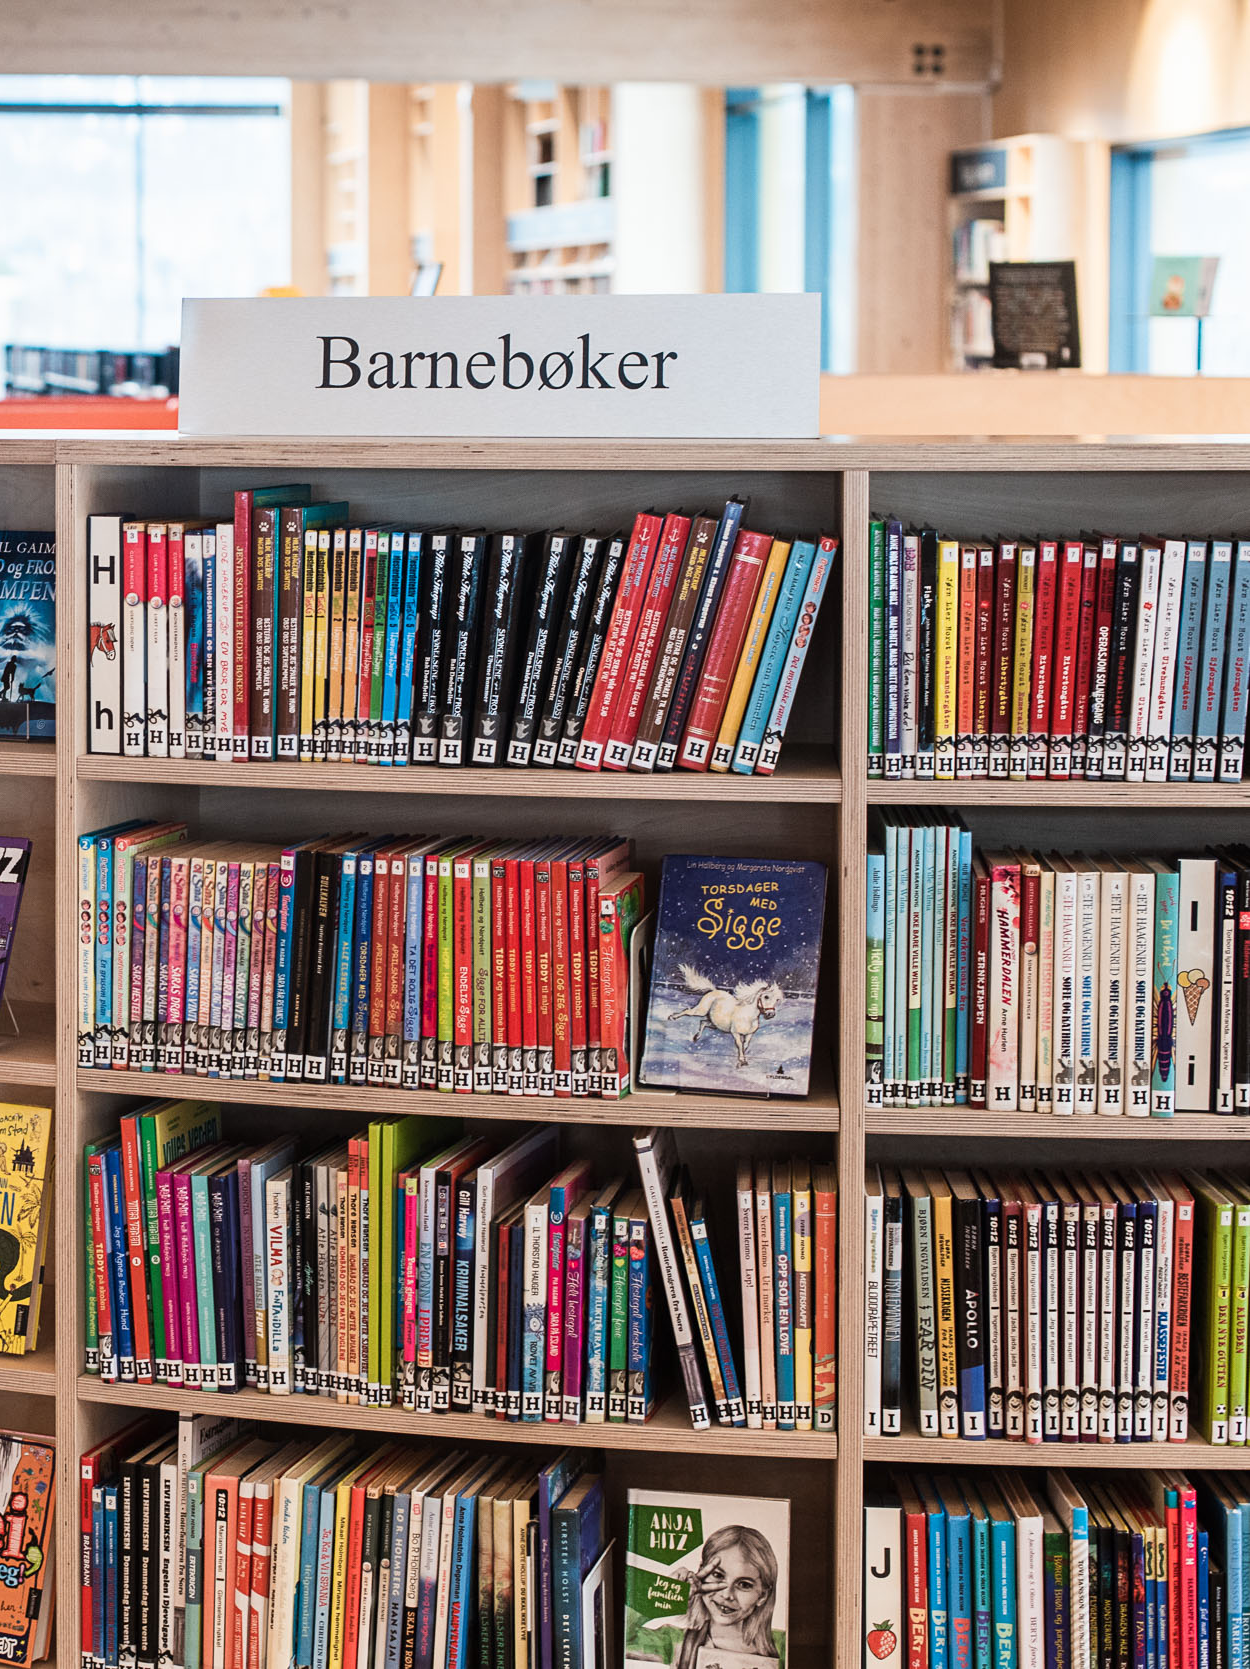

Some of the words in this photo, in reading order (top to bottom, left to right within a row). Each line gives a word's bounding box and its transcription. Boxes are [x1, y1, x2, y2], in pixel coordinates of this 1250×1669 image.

[315, 332, 678, 392] Barnebøker
[221, 535, 229, 564] LINDE
[236, 546, 244, 575] JENTA
[8, 563, 22, 578] og
[94, 556, 115, 584] H
[221, 570, 230, 612] HAGERUP
[236, 578, 244, 599] SOM
[236, 602, 244, 627] VILLE
[236, 630, 244, 662] REDDE
[1097, 626, 1110, 673] OPERASJON
[792, 656, 800, 669] Det
[236, 664, 244, 704] BØKENE
[781, 672, 797, 703] mystiske
[942, 656, 953, 729] Salamandergåten
[999, 656, 1010, 716] Libertygåten
[1037, 656, 1047, 719] Rivertongåten
[1094, 674, 1108, 724] SOLNEDGANG
[1158, 656, 1169, 720] Ulvehundgåten
[1206, 657, 1217, 711] Sjøormgåten
[96, 701, 113, 730] h
[775, 706, 786, 726] ranet
[687, 861, 698, 870] Lin
[700, 861, 726, 872] Hallberg
[727, 865, 736, 873] og
[738, 863, 771, 874] Margareta
[772, 864, 805, 875] Nordqvist
[701, 882, 779, 895] TORSDAGER
[1225, 890, 1235, 916] 10:12
[750, 898, 777, 911] MED
[698, 898, 782, 951] Sigge
[996, 910, 1011, 1006] HAMMERDALEN
[460, 967, 468, 1003] ENDELIG
[976, 950, 986, 1024] JERNKJEMPEN
[458, 1191, 470, 1206] Gill
[456, 1208, 470, 1238] Harvey
[1009, 1219, 1017, 1245] 10:12
[270, 1226, 284, 1267] VILMA
[1010, 1253, 1018, 1270] Bjørn
[778, 1254, 788, 1277] OPP
[779, 1280, 788, 1306] SOM
[798, 1273, 807, 1328] MESTERSKAPET
[940, 1278, 951, 1322] NISSEKRIGEN
[1010, 1272, 1018, 1305] Ingvaldsen
[1176, 1273, 1189, 1327] BESTEFARKRIGEN
[121, 1309, 129, 1330] Hund
[454, 1260, 470, 1351] KRIMINALSAKER
[780, 1309, 789, 1324] EN
[1218, 1305, 1227, 1324] DEN
[780, 1327, 790, 1355] LØVE
[918, 1317, 934, 1351] FAR
[1156, 1312, 1168, 1381] KLASSEFESTEN
[1218, 1328, 1227, 1347] NYE
[1236, 1308, 1245, 1354] KLUBBEN
[921, 1357, 936, 1391] DIN
[1217, 1350, 1227, 1388] GUTTEN
[142, 1478, 150, 1498] LEVI
[218, 1492, 226, 1518] 10:12
[459, 1506, 467, 1524] Anna
[142, 1500, 150, 1551] HENRIKSEN
[650, 1514, 693, 1532] ANJA
[456, 1526, 466, 1562] Holmström
[650, 1530, 688, 1551] HITZ
[84, 1535, 93, 1587] BRÅTEBRANN
[337, 1542, 346, 1576] Holmberg
[392, 1538, 403, 1596] HOLMBERG
[871, 1548, 891, 1579] J
[140, 1557, 149, 1606] Dommedag
[319, 1576, 329, 1607] SPANIA
[453, 1564, 464, 1599] Degerman
[648, 1586, 685, 1602] familien
[653, 1576, 668, 1589] Jeg
[669, 1582, 681, 1592] og
[391, 1602, 399, 1626] HAN
[655, 1600, 672, 1611] min
[332, 1614, 342, 1661] hemmelighet
[390, 1630, 398, 1641] SA
[910, 1608, 926, 1653] BERT
[932, 1610, 947, 1654] BERT
[1232, 1618, 1241, 1656] FARLIG
[389, 1645, 398, 1661] JA!
